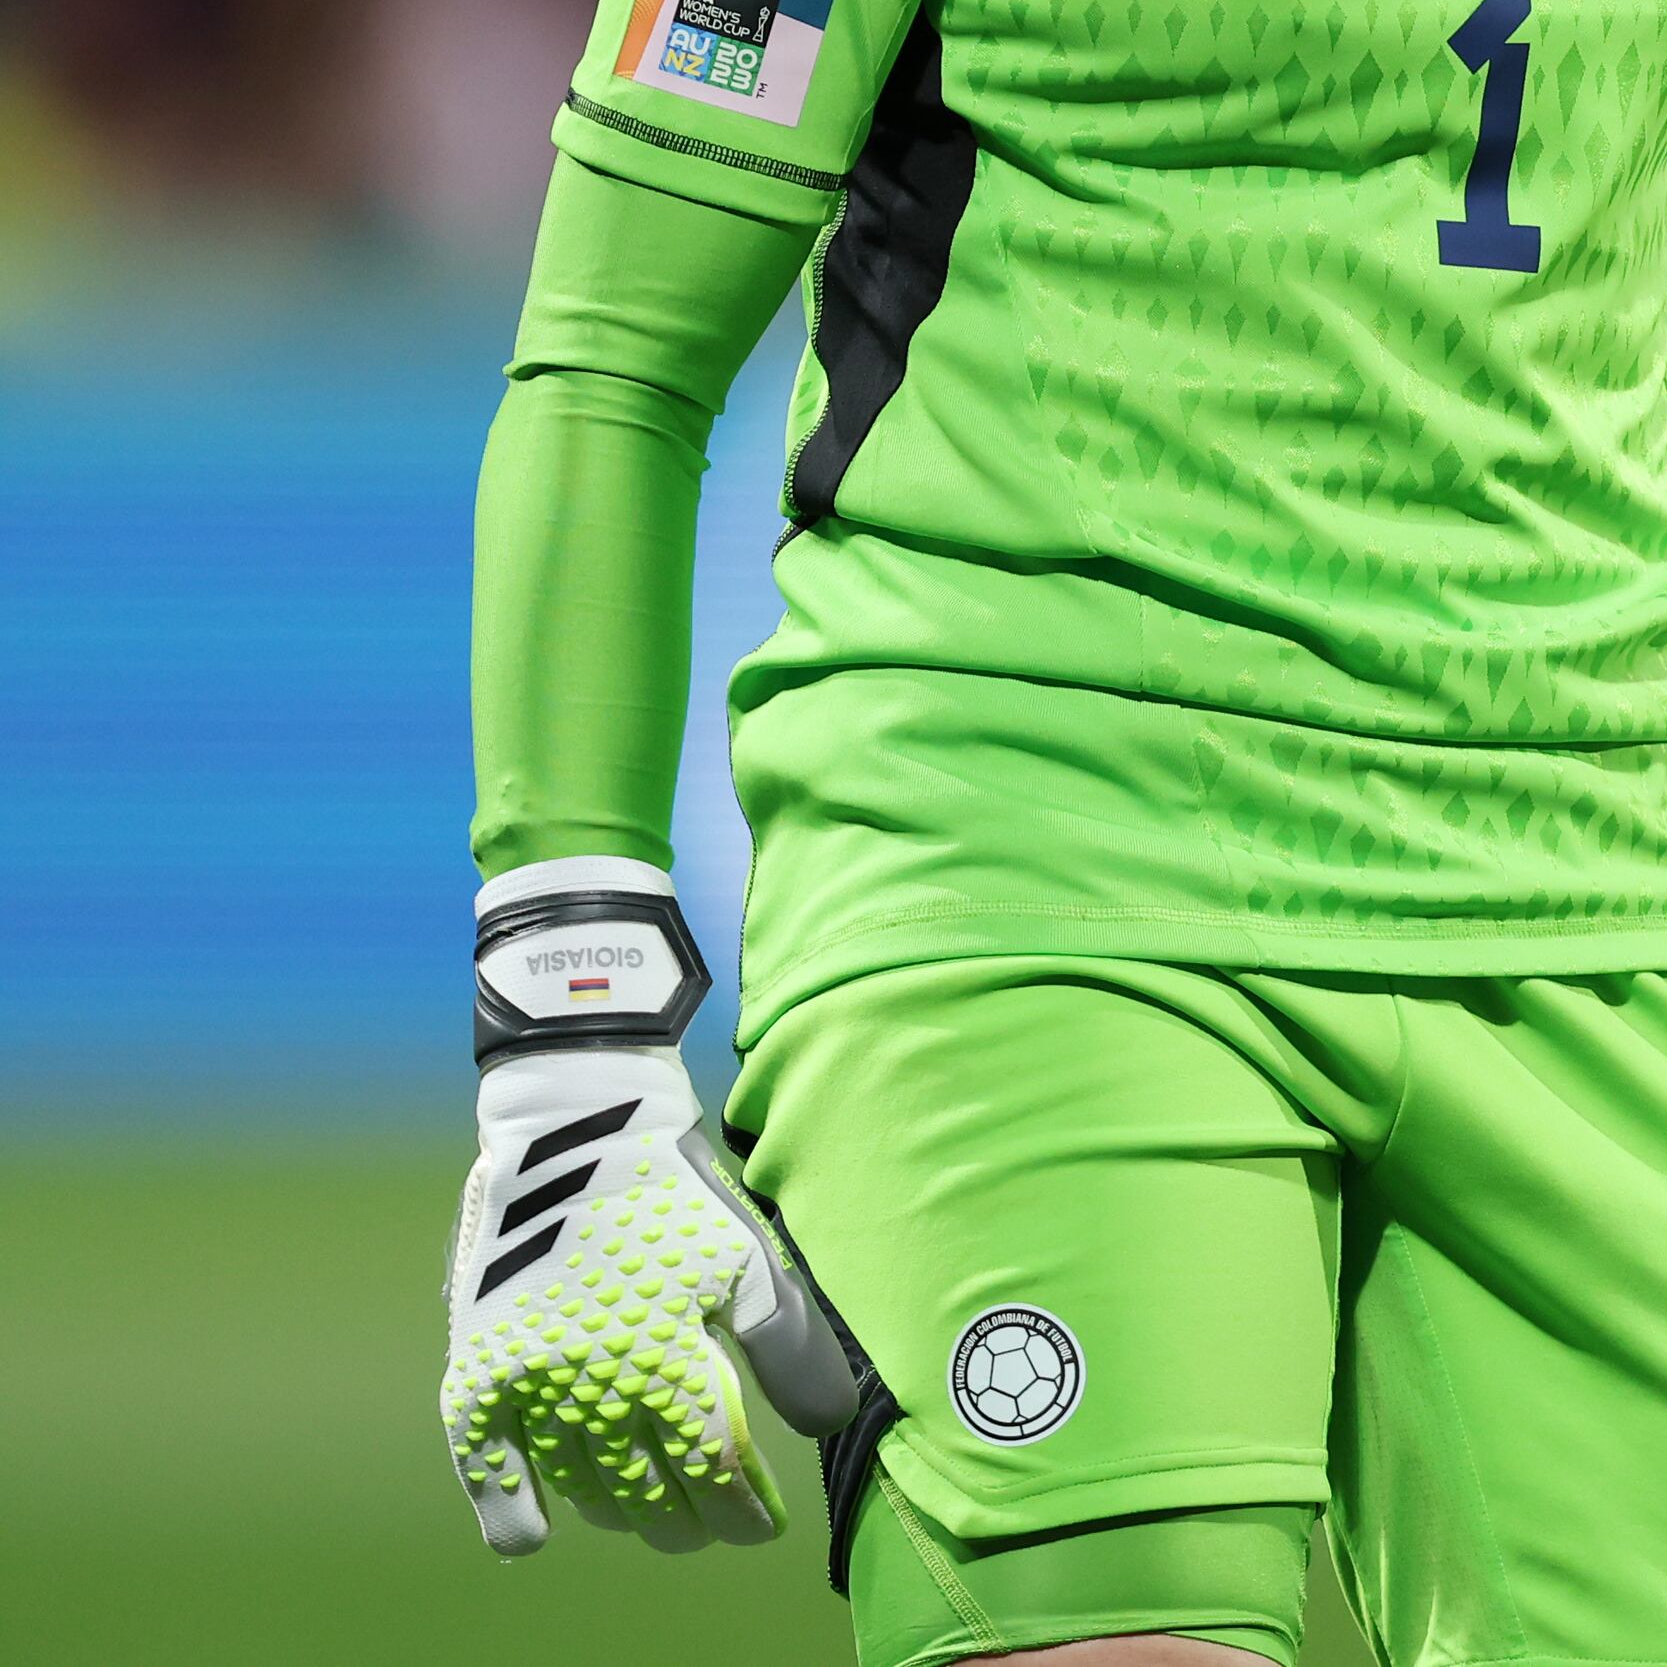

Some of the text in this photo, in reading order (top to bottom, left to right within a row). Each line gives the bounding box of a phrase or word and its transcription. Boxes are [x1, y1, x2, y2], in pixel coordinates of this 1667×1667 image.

[679, 8, 751, 37] WORLD CUP
[669, 28, 712, 56] AU
[663, 48, 705, 77] NZ
[710, 1156, 793, 1270] PREDATOR
[955, 1312, 1074, 1389] FEDERACION COLOMBIANA DE FUTBOL
